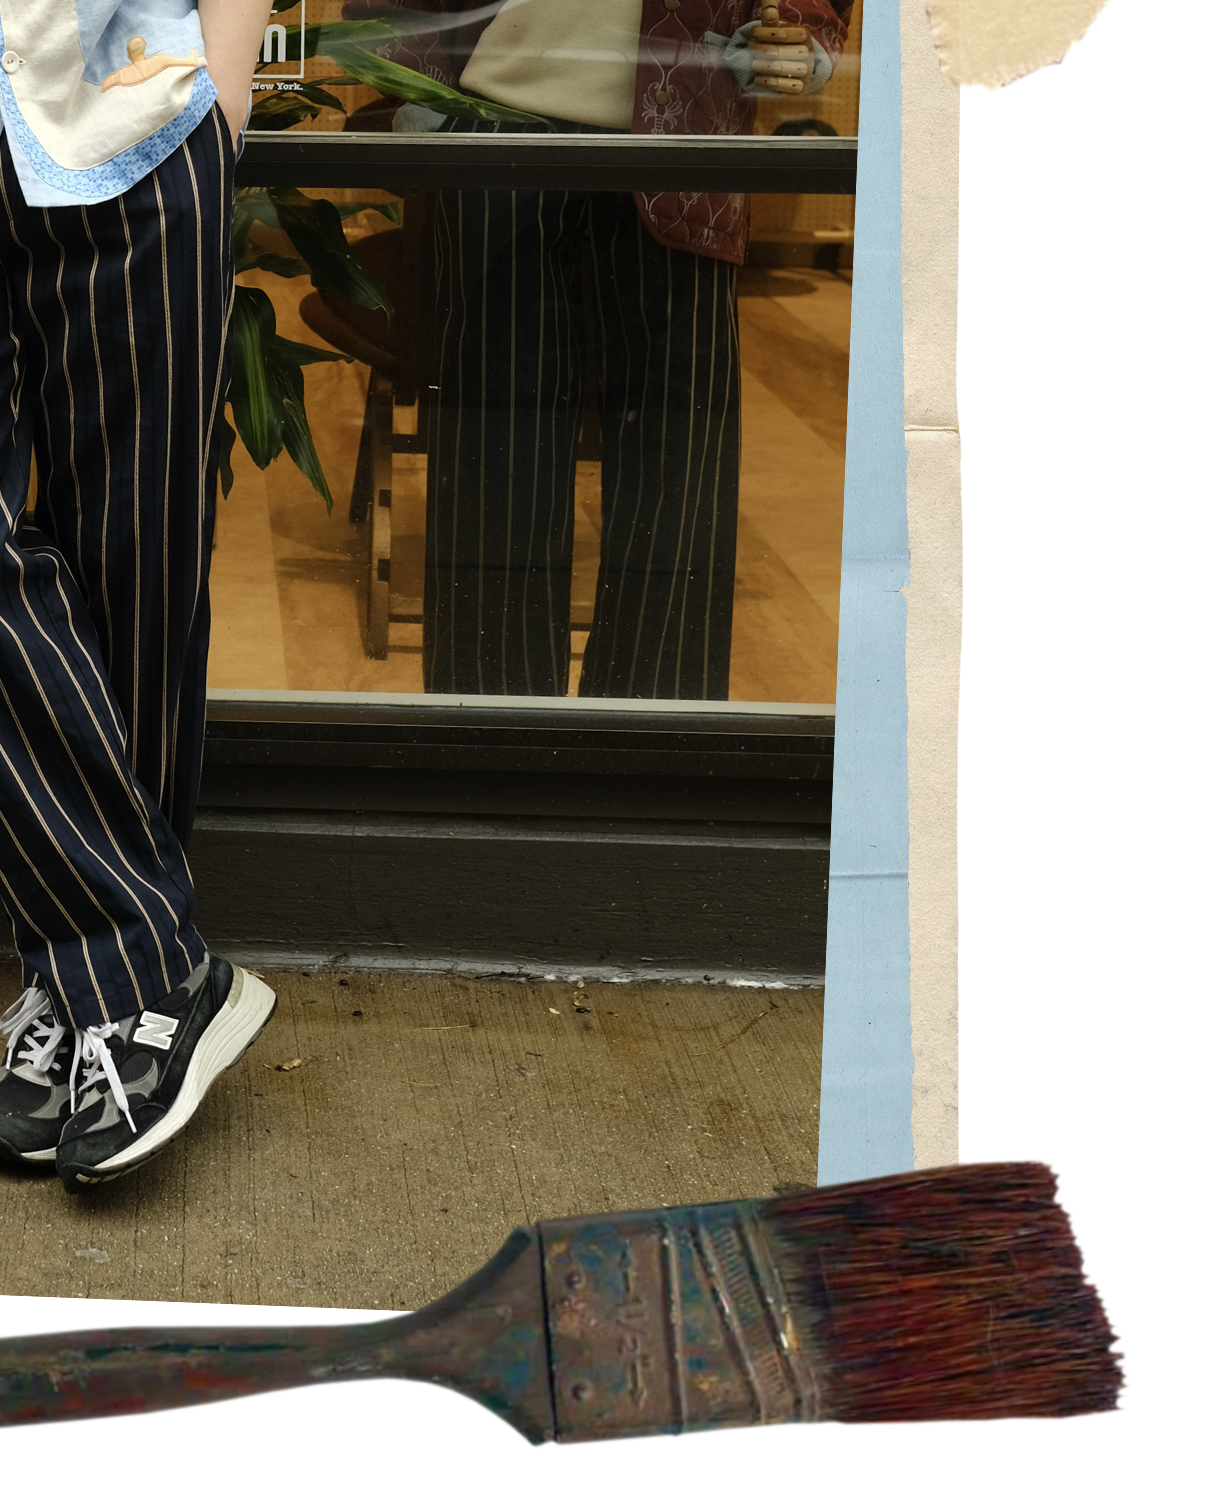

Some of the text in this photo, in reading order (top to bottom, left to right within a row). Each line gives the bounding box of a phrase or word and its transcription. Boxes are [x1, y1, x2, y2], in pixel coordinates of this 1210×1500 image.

[251, 82, 303, 91] New York.
[133, 1010, 179, 1050] N
